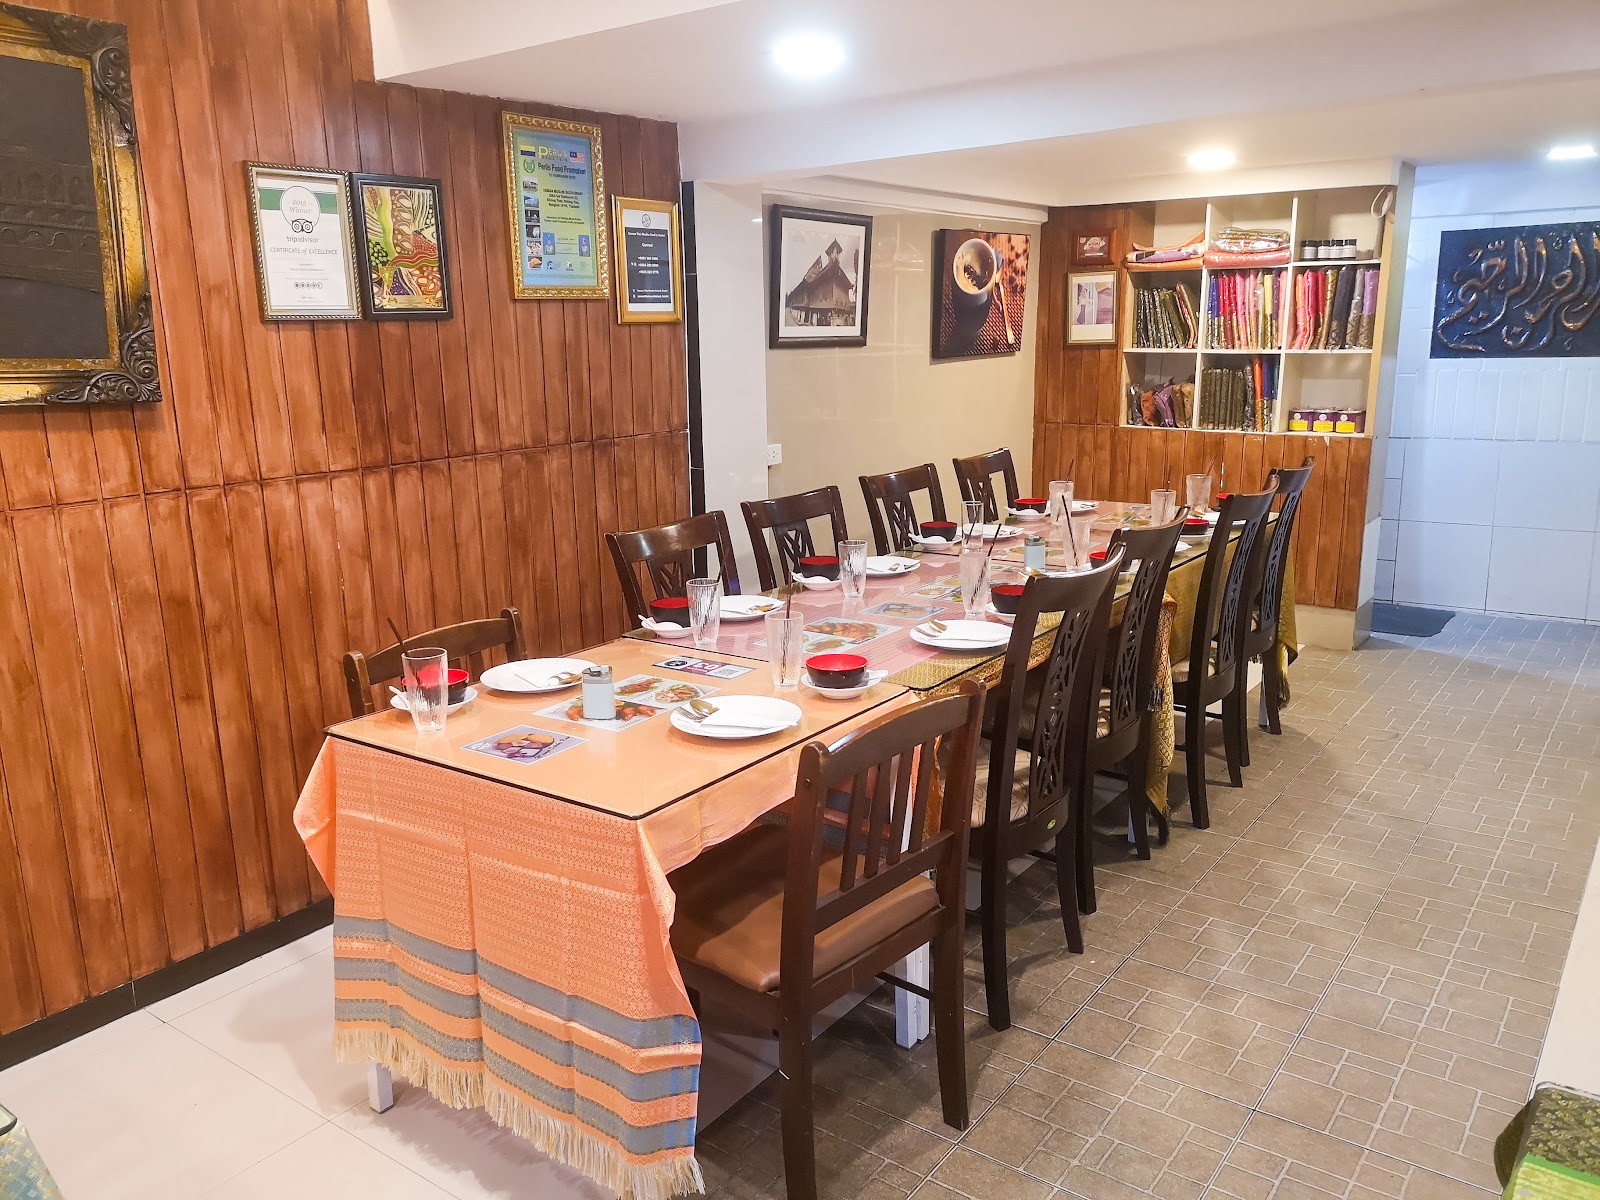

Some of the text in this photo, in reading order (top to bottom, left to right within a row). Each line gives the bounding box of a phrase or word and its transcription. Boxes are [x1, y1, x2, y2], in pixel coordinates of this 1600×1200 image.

[538, 162, 586, 174] Perlis Food Promotion
[308, 248, 338, 256] EXCELLENCE
